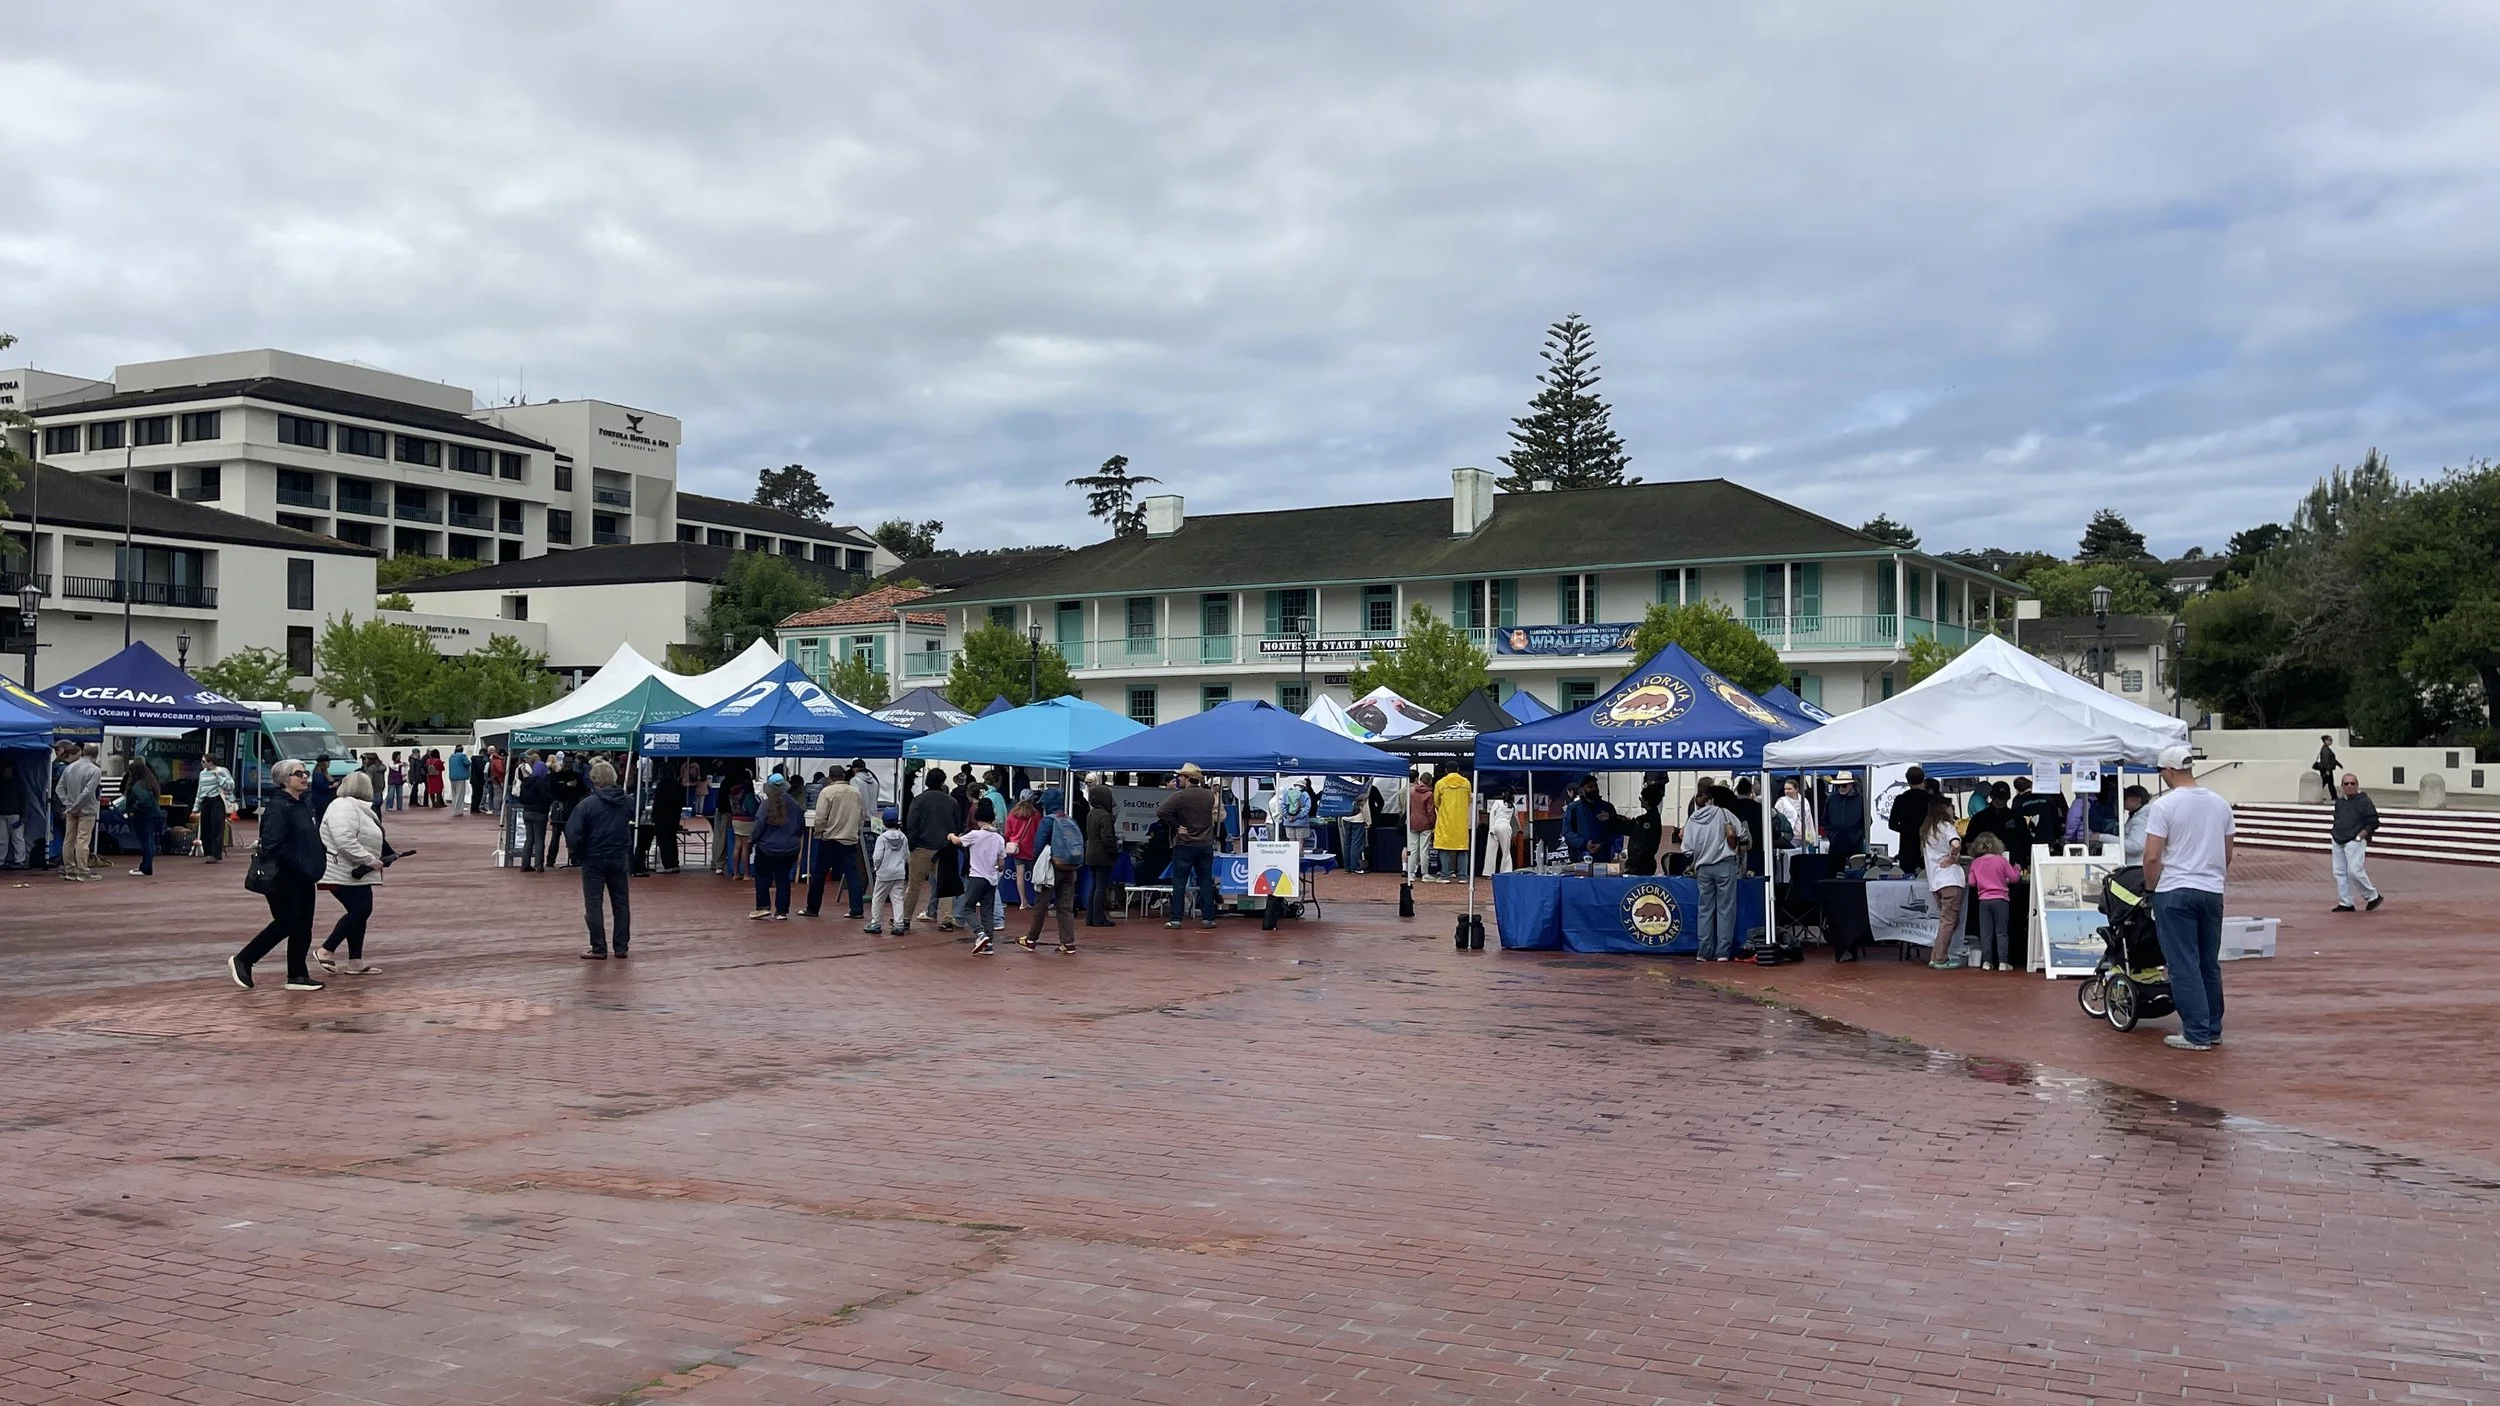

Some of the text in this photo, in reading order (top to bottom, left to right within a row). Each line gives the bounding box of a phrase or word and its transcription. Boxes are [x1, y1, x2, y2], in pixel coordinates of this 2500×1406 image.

[598, 427, 628, 440] PORTOLA
[629, 433, 651, 445] HOTEL
[658, 439, 670, 448] SPA
[426, 625, 450, 634] HOTEL
[458, 627, 470, 635] SPA
[1322, 639, 1357, 650] STATE
[1360, 638, 1408, 650] HISTOR
[1529, 634, 1620, 649] WHALEFEST
[58, 685, 176, 705] OCEANA
[1595, 676, 1692, 728] CALIFORNIA STATE PARKS
[98, 708, 130, 718] Oceans
[138, 710, 211, 724] www.oceana.org
[514, 733, 627, 746] PGMuseum.org @PGMuseum
[654, 733, 681, 743] SURFRIDER
[789, 734, 825, 744] SURFRIDER
[1496, 740, 1744, 761] CALIFORNIA STATE PARKS
[1123, 799, 1135, 808] Sea
[1136, 800, 1156, 809] Otter
[1622, 885, 1681, 945] CALIFORNIA STATE PARKS
